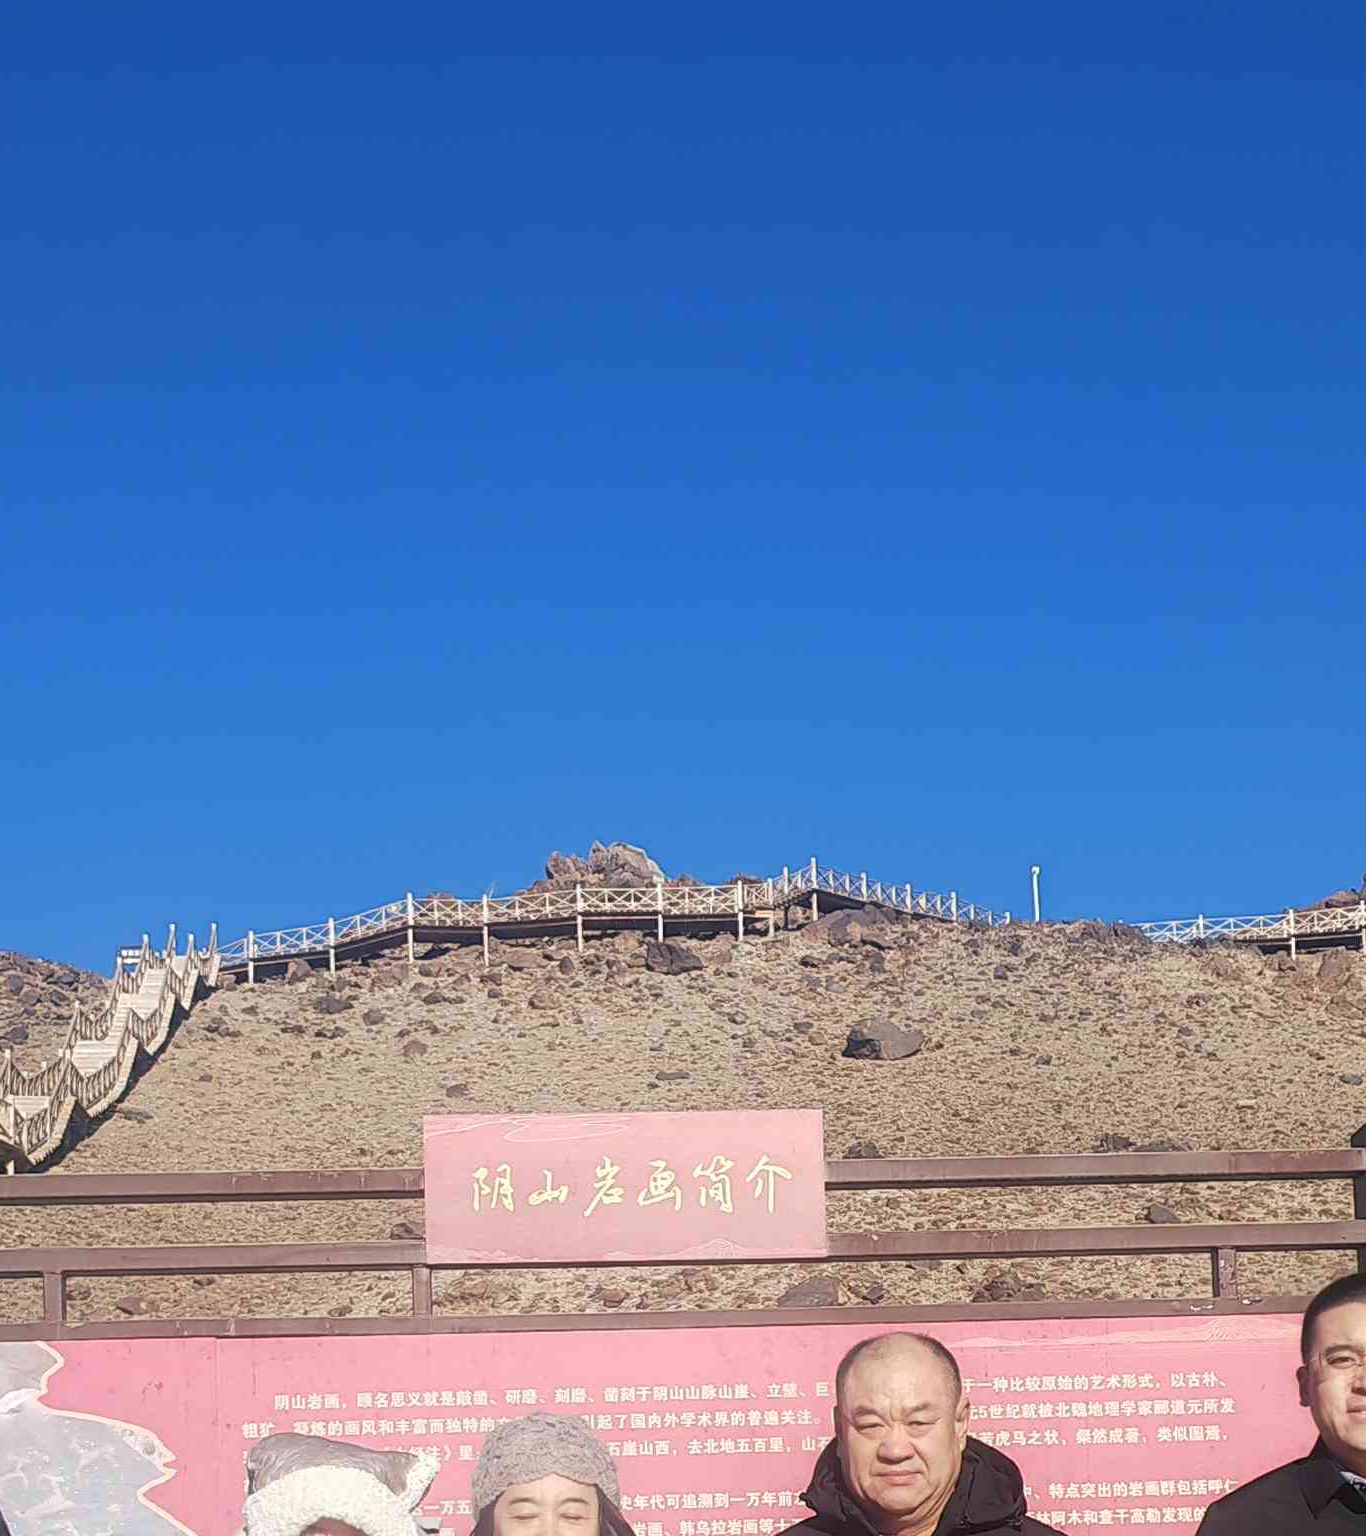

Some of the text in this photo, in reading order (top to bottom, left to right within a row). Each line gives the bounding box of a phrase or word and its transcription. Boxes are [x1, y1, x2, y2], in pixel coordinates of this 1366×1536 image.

[471, 1154, 793, 1217] 阴山岩画简介
